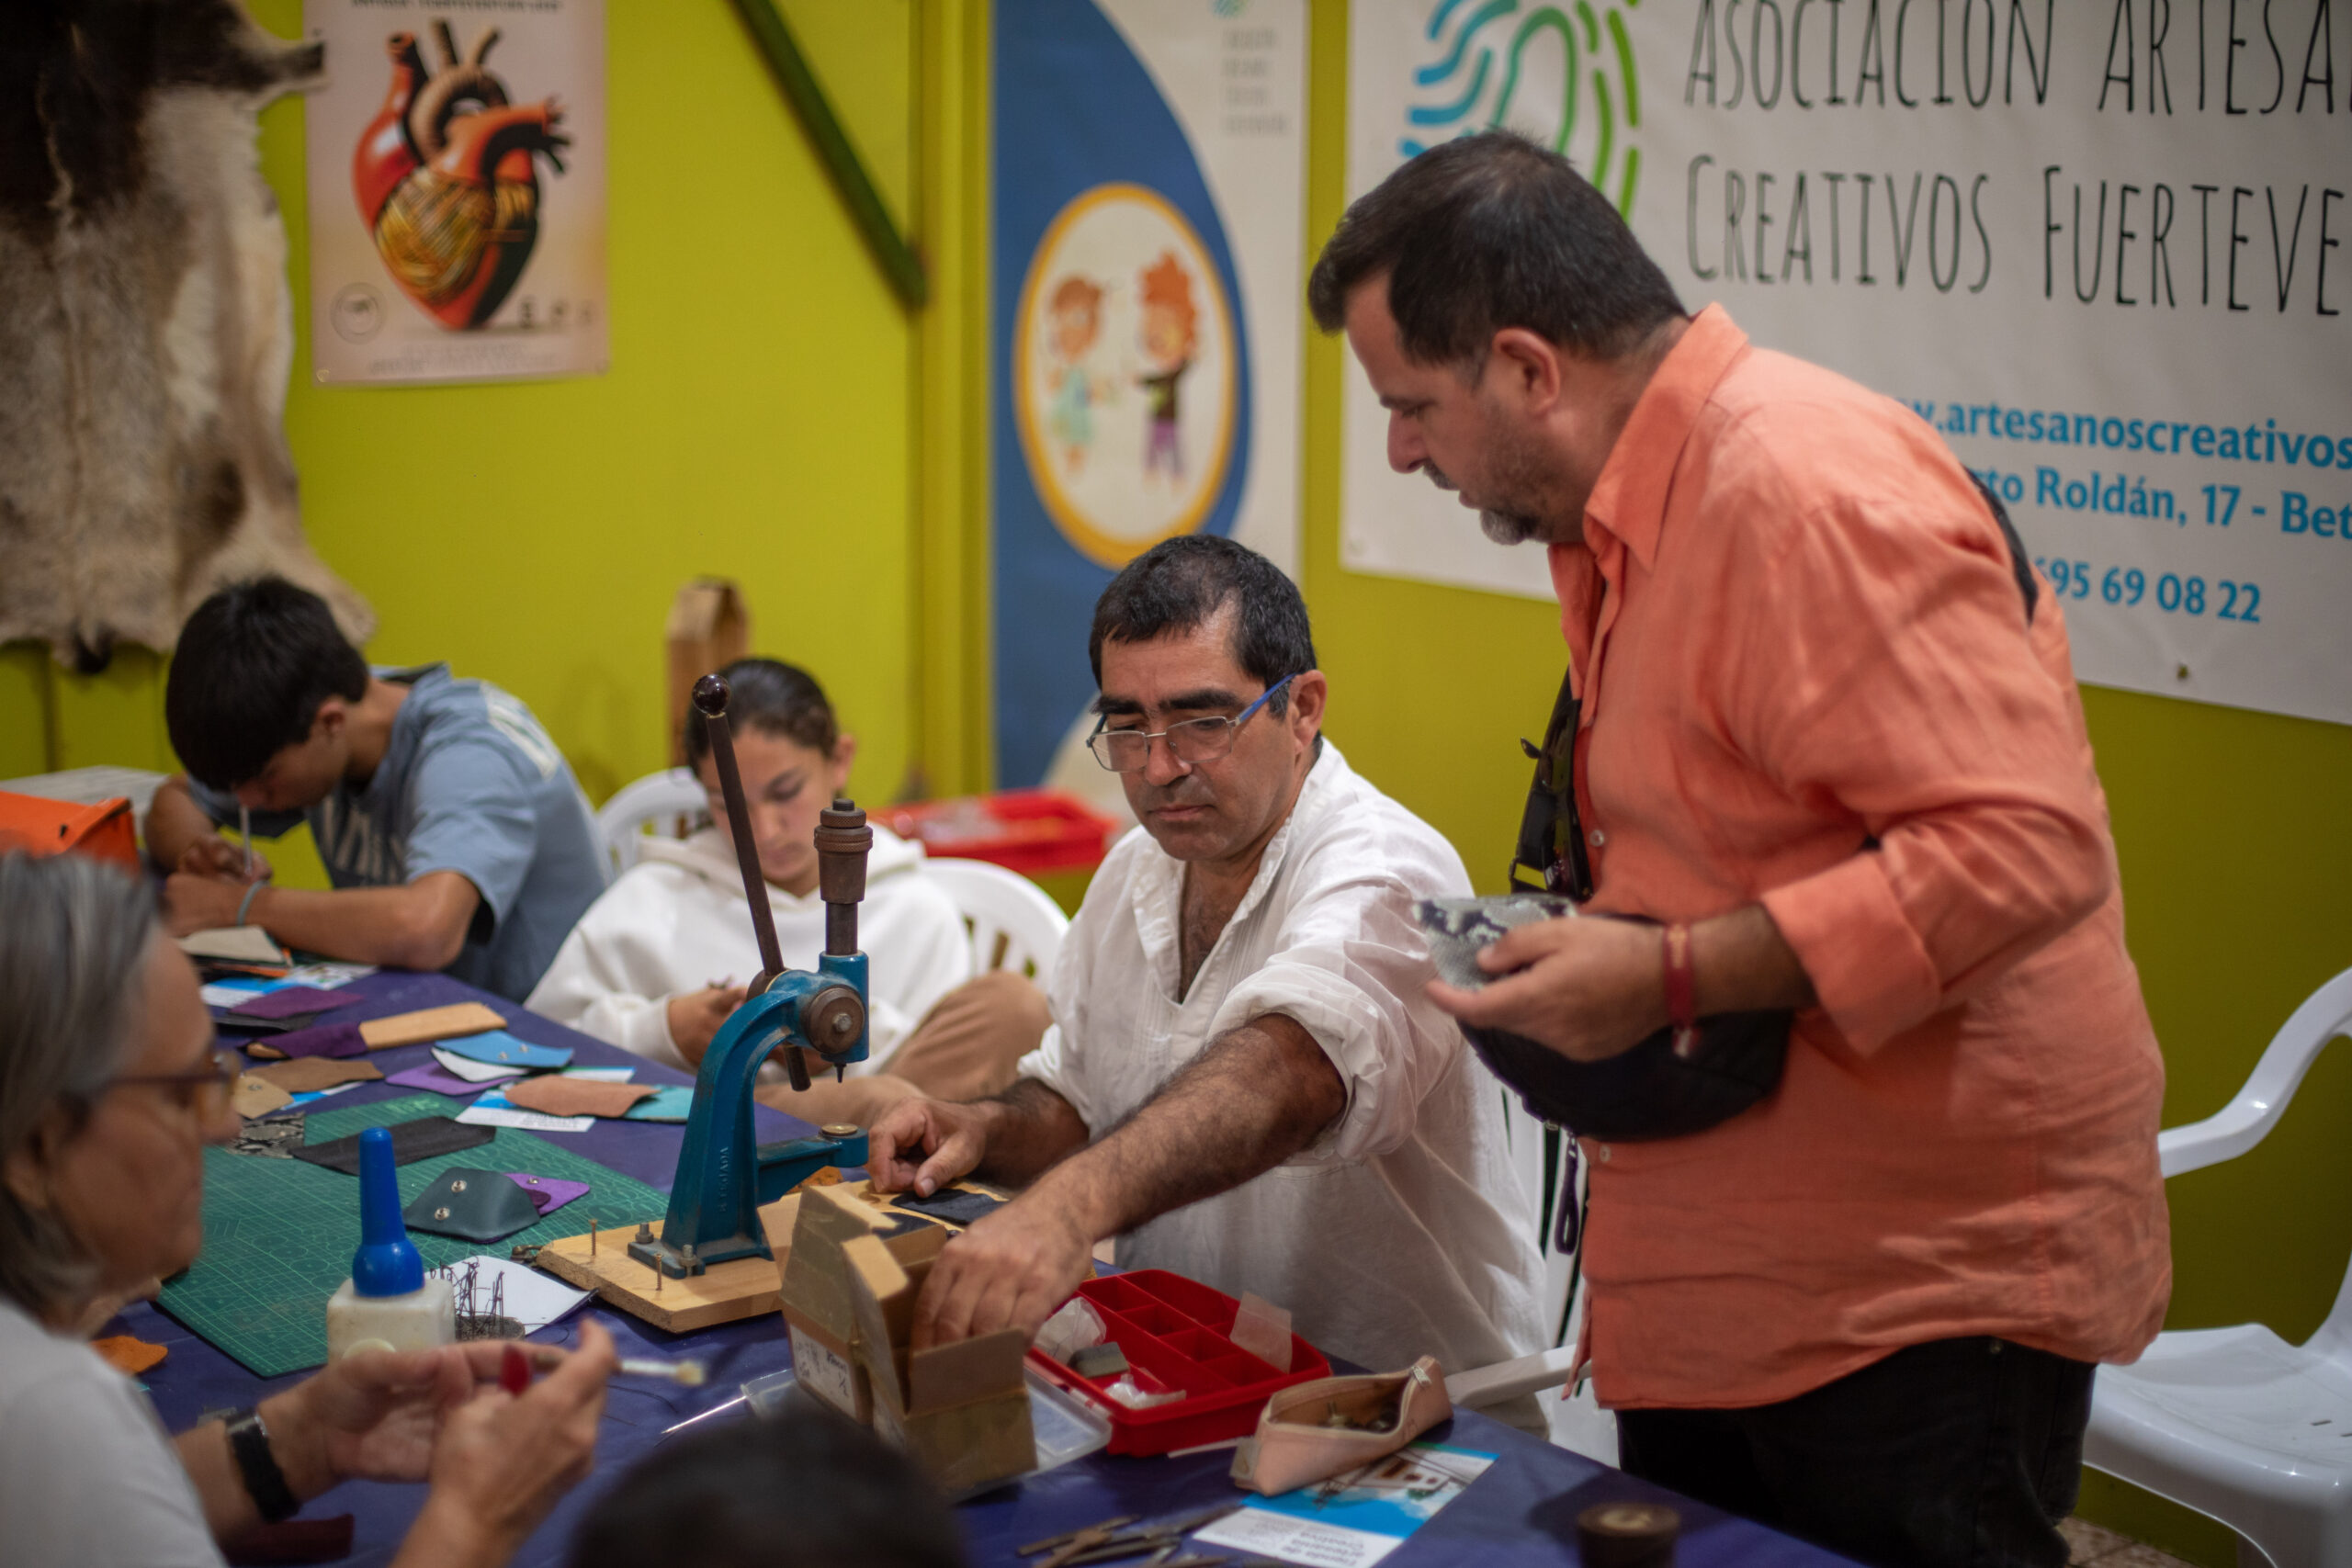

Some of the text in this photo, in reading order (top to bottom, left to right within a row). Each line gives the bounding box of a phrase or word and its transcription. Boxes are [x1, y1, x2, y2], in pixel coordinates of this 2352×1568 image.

[2098, 0, 2352, 115] ARTESA
[1687, 154, 2344, 315] CREATIVOS FUERTEVE
[2035, 466, 2187, 527] Roldán,
[2201, 484, 2241, 526] 17
[2101, 566, 2145, 606] 69
[2156, 571, 2207, 615] 08
[2217, 580, 2260, 624] 22
